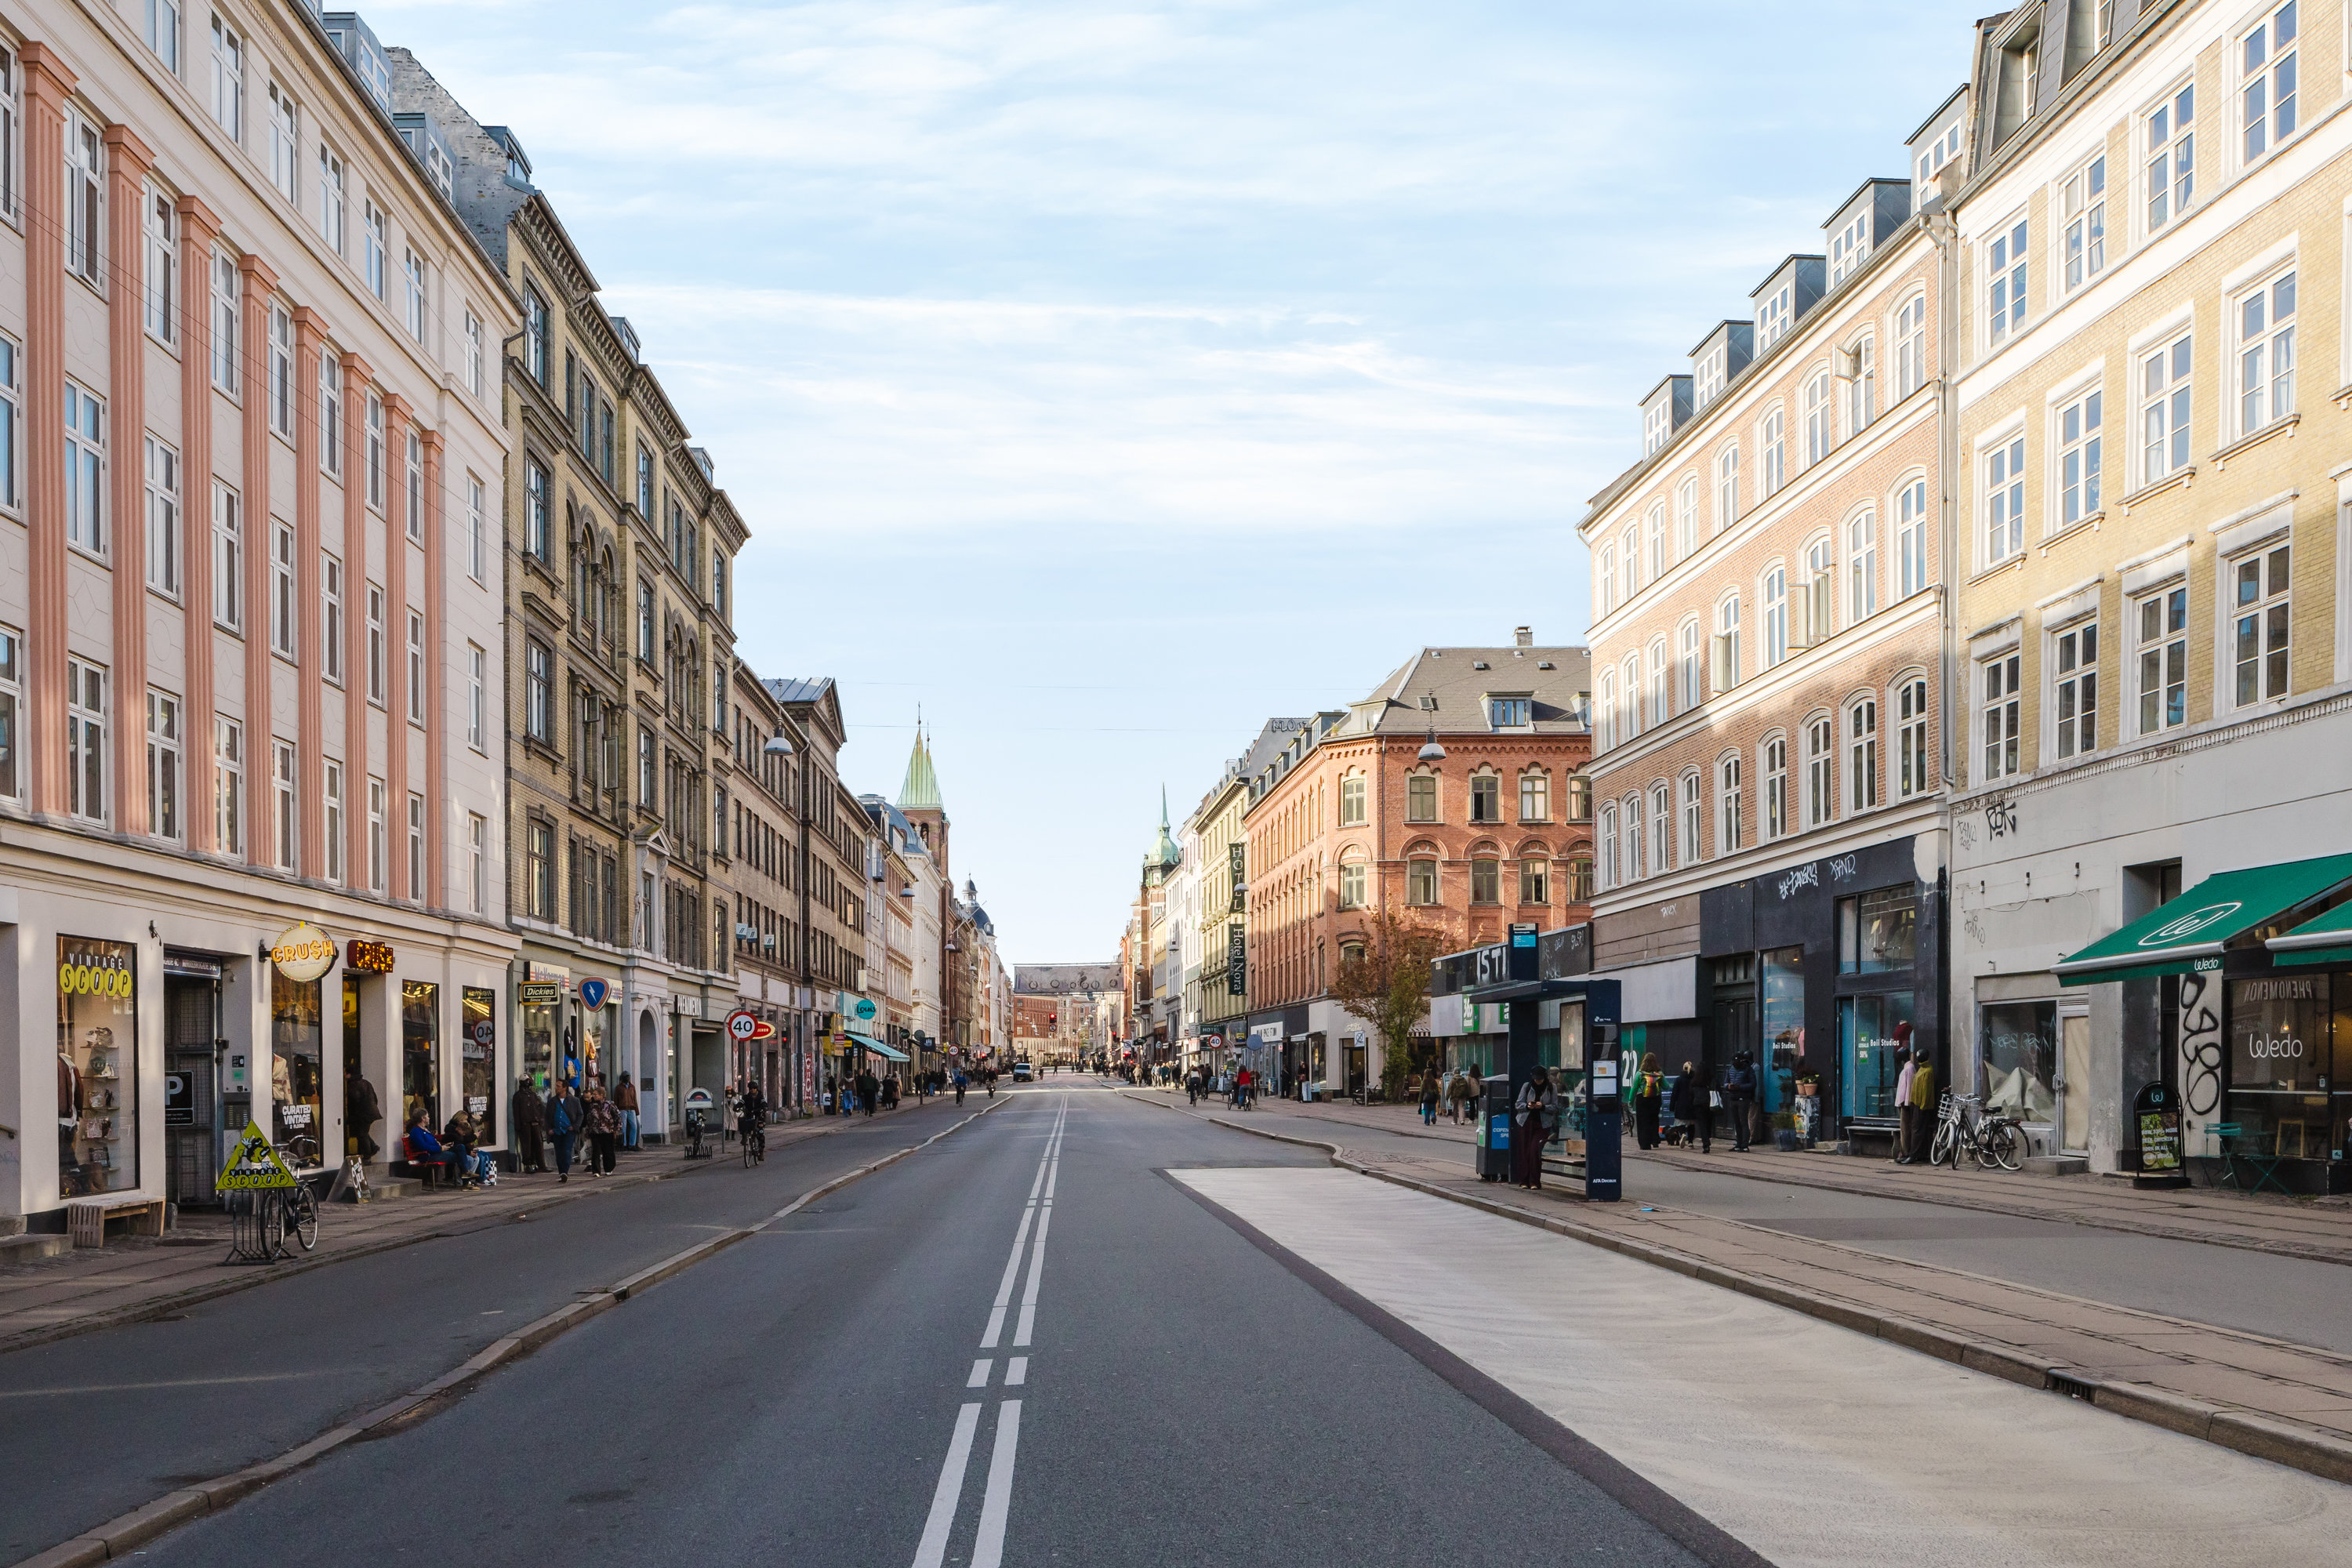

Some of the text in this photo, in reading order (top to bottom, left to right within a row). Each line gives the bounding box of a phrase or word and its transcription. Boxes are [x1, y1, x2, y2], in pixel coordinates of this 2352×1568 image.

[69, 953, 122, 970] VINTAGE
[1234, 927, 1244, 990] Hotel Nora
[2194, 957, 2219, 971] Wedo
[64, 968, 129, 993] SCOOP
[856, 1004, 877, 1014] Louis
[733, 1021, 753, 1033] 40
[1881, 1038, 1900, 1047] Studios
[2249, 1033, 2303, 1058] Wedo
[164, 1076, 184, 1105] P
[282, 1104, 311, 1115] CURATED
[284, 1113, 310, 1124] VINTAGE
[227, 1176, 285, 1186] SCOOP
